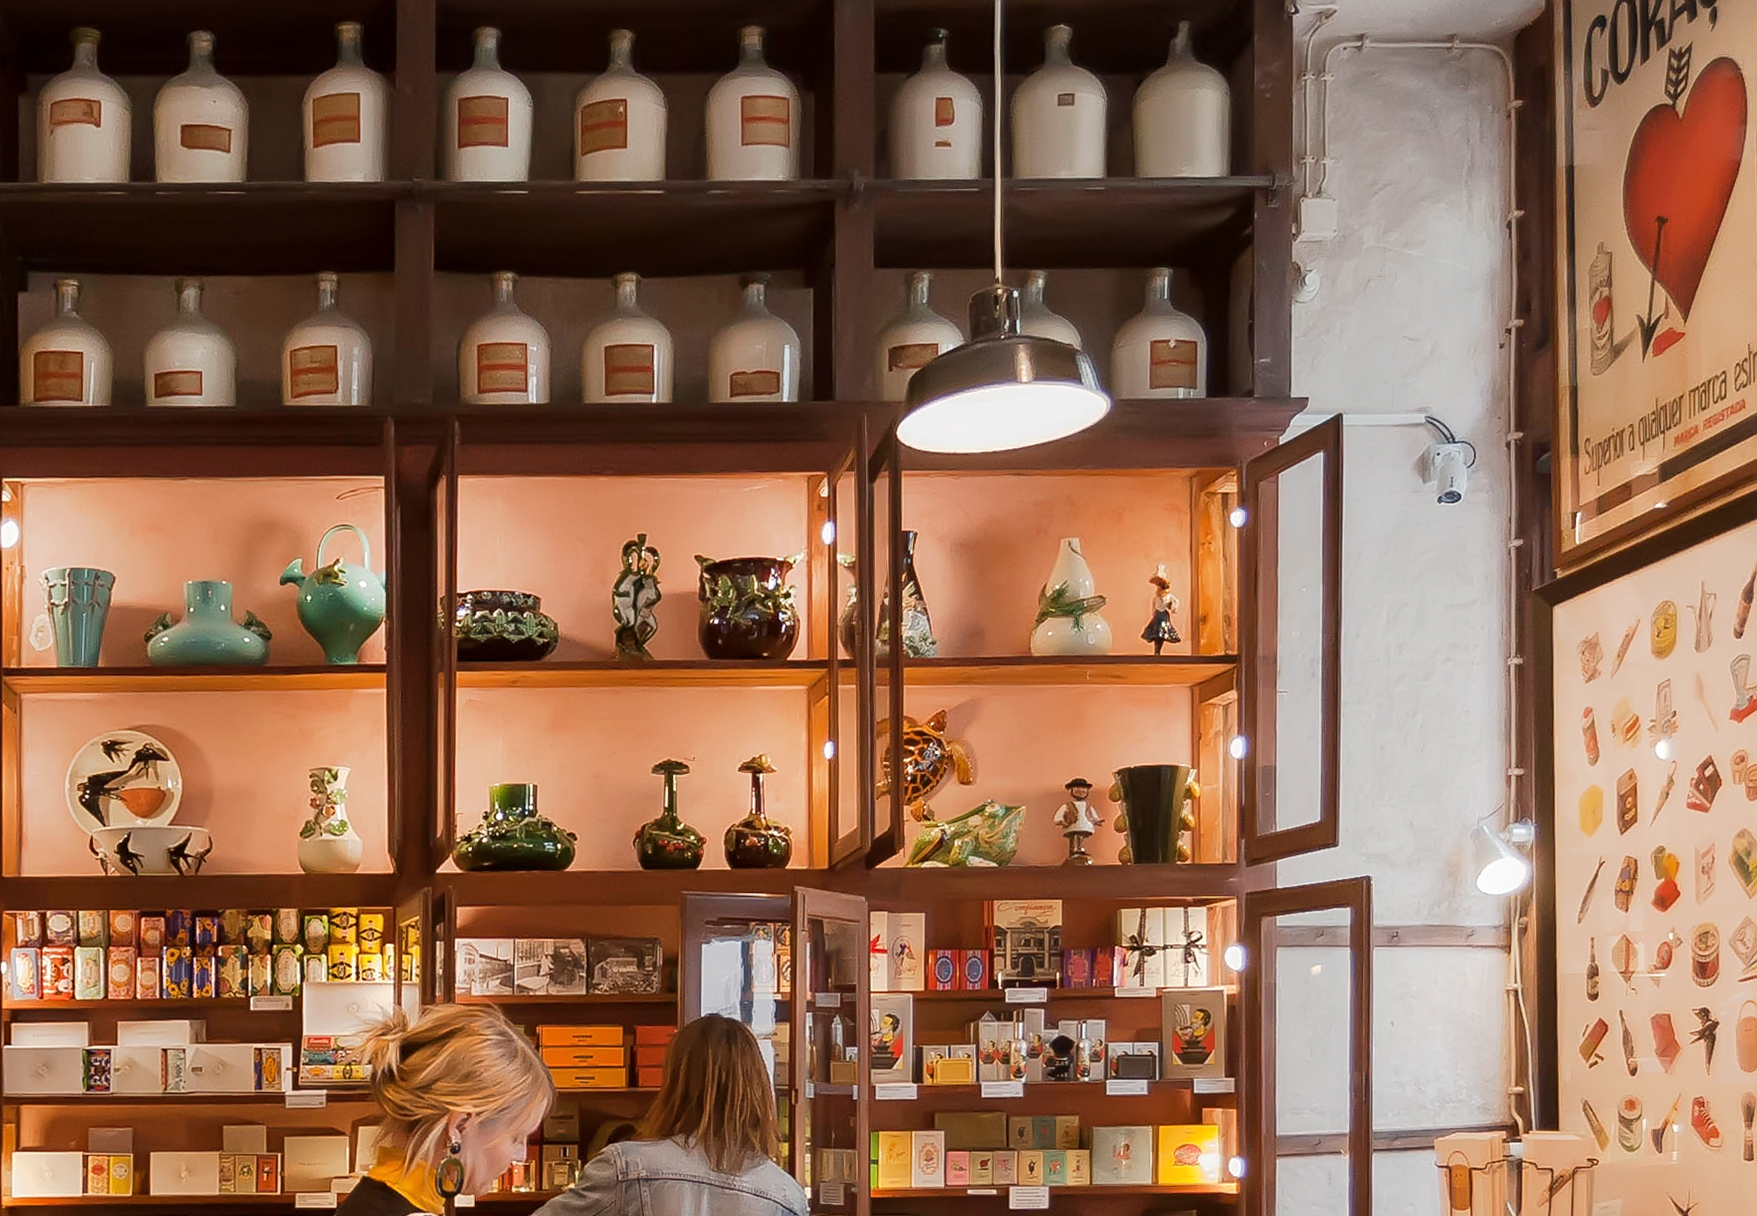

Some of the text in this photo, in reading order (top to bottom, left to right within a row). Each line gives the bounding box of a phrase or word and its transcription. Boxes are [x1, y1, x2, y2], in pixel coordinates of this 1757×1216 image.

[1583, 0, 1718, 108] COR
[1584, 427, 1625, 486] Superior
[1628, 423, 1635, 452] a
[1638, 392, 1684, 462] qualquer
[1688, 370, 1727, 419] marca
